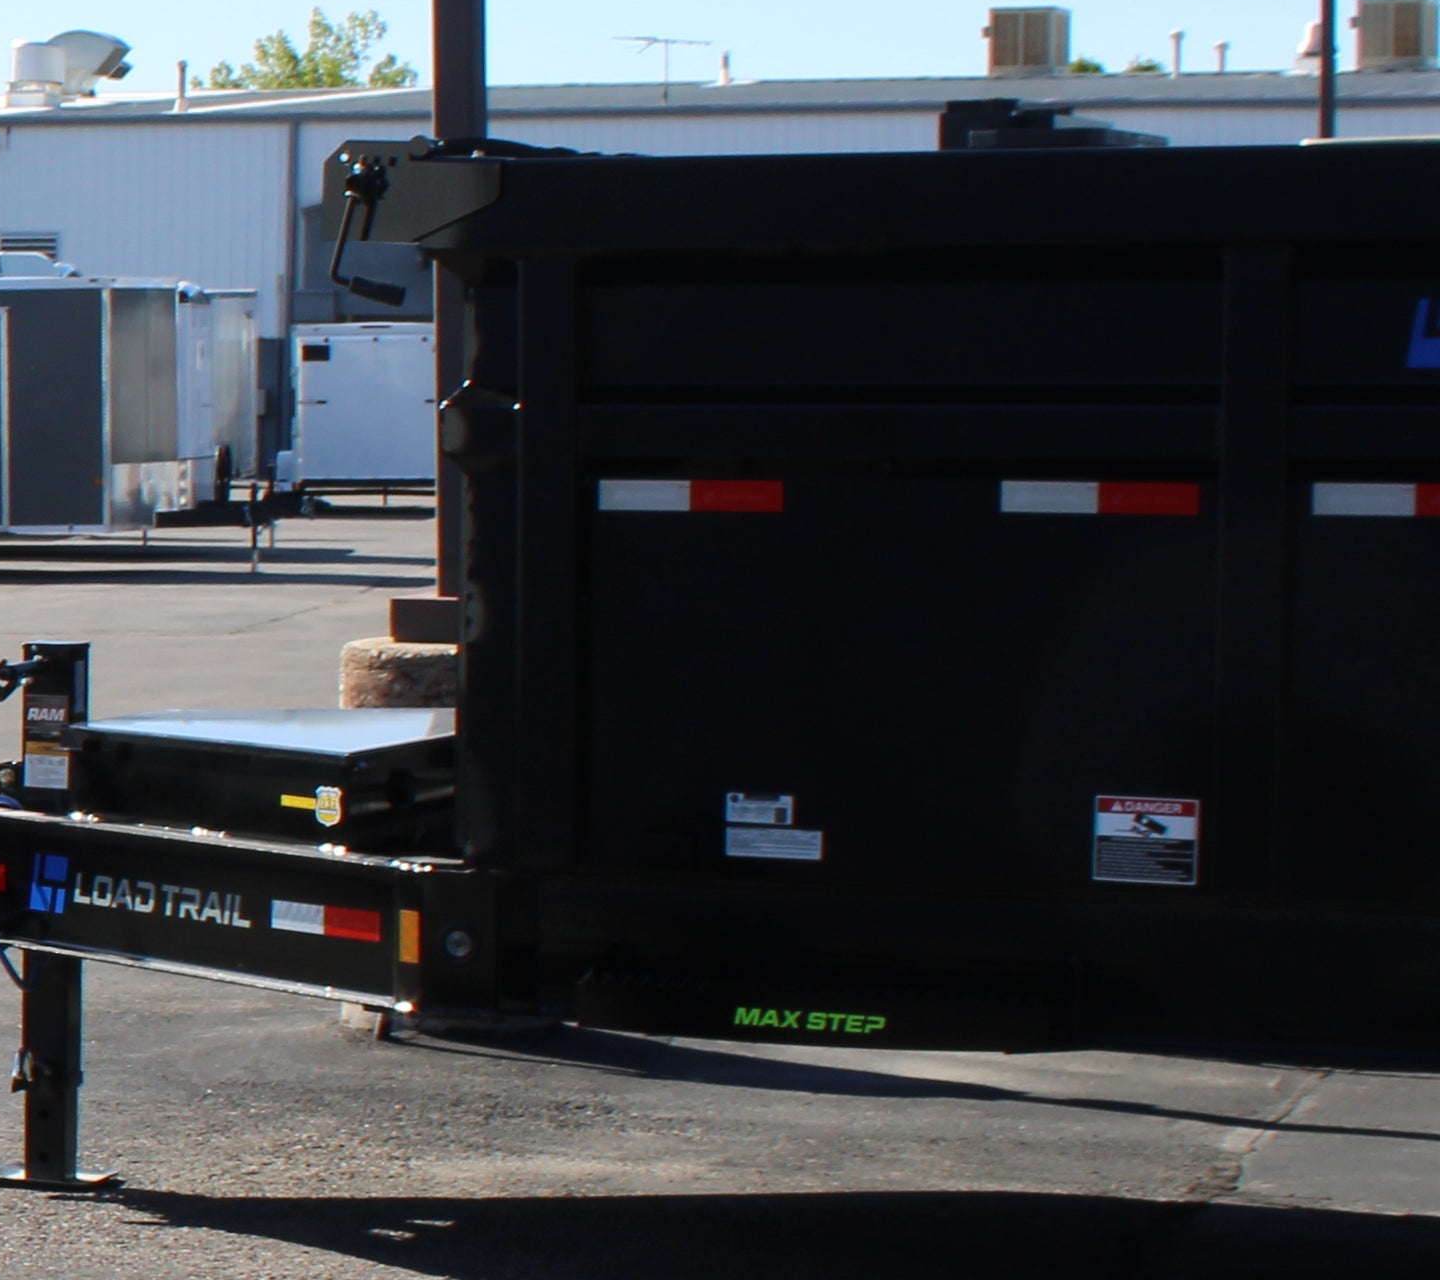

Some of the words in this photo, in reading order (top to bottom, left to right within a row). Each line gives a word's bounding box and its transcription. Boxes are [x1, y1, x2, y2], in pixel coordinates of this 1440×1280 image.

[27, 707, 66, 722] RAM
[1124, 801, 1183, 814] DANGER
[734, 1006, 803, 1029] MAX
[806, 1011, 887, 1034] STEP
